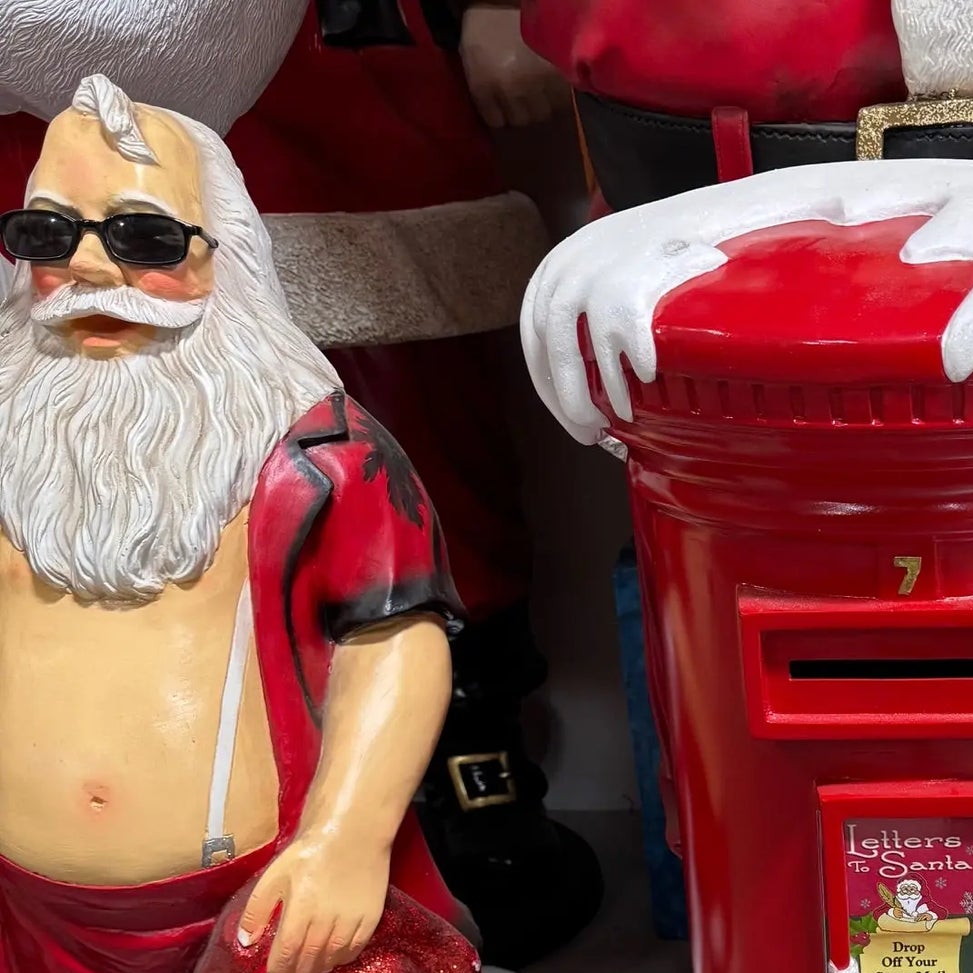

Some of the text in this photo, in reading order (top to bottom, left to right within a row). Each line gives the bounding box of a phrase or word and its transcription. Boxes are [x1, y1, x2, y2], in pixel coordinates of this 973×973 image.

[893, 556, 922, 596] 7
[846, 824, 962, 859] Letters
[847, 850, 972, 878] To Santa
[881, 956, 938, 968] Off Your
[892, 941, 925, 956] Drop
